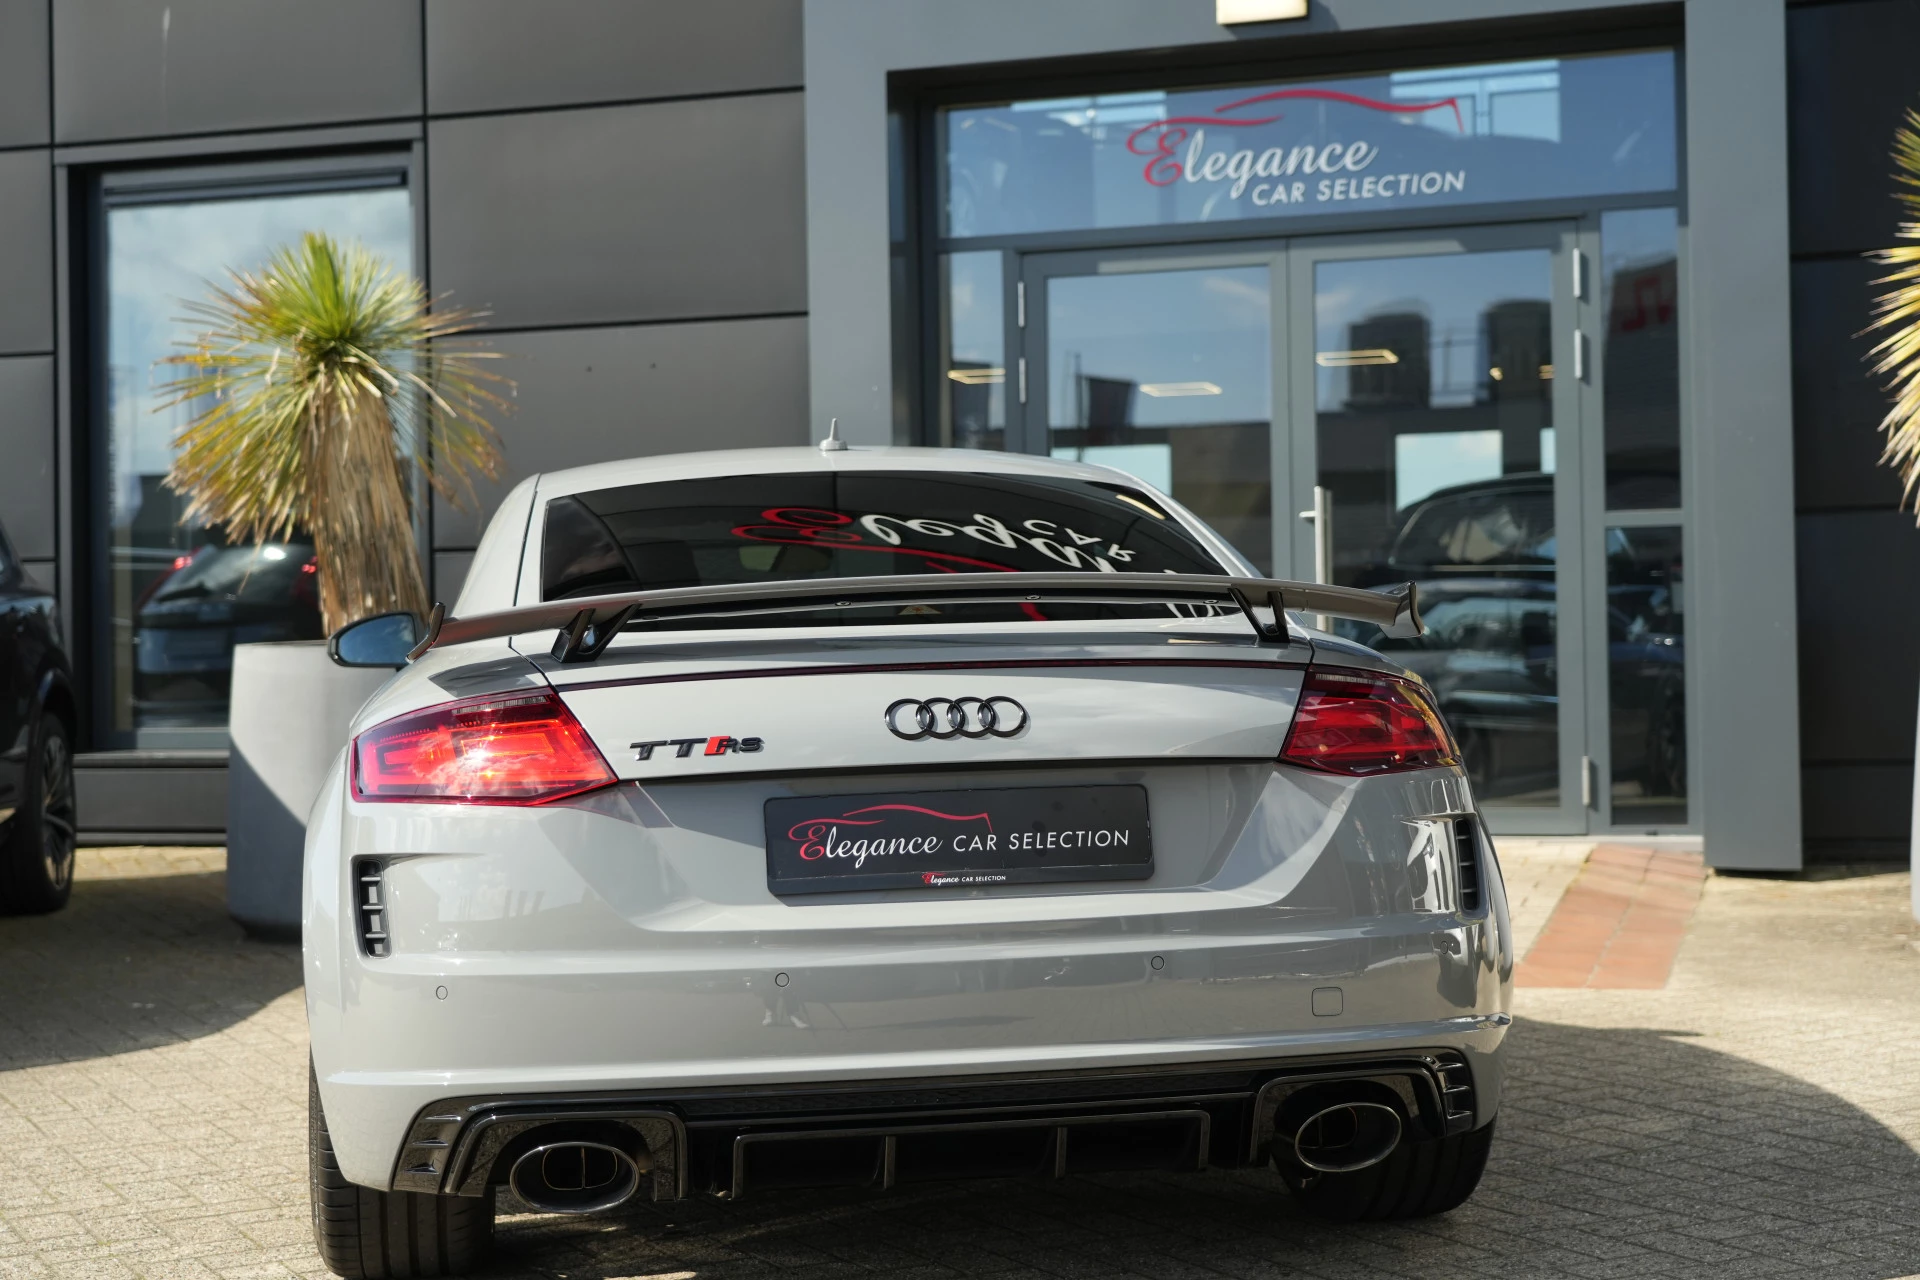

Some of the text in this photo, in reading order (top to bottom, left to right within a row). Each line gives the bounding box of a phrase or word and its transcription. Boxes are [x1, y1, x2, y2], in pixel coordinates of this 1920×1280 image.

[1127, 117, 1379, 199] Elegance
[1252, 171, 1465, 206] CAR SELECTION
[629, 738, 708, 761] TT
[788, 819, 1130, 869] Elegance CAR SELECTION
[922, 872, 959, 886] Elegance
[975, 875, 1007, 883] SELECTION
